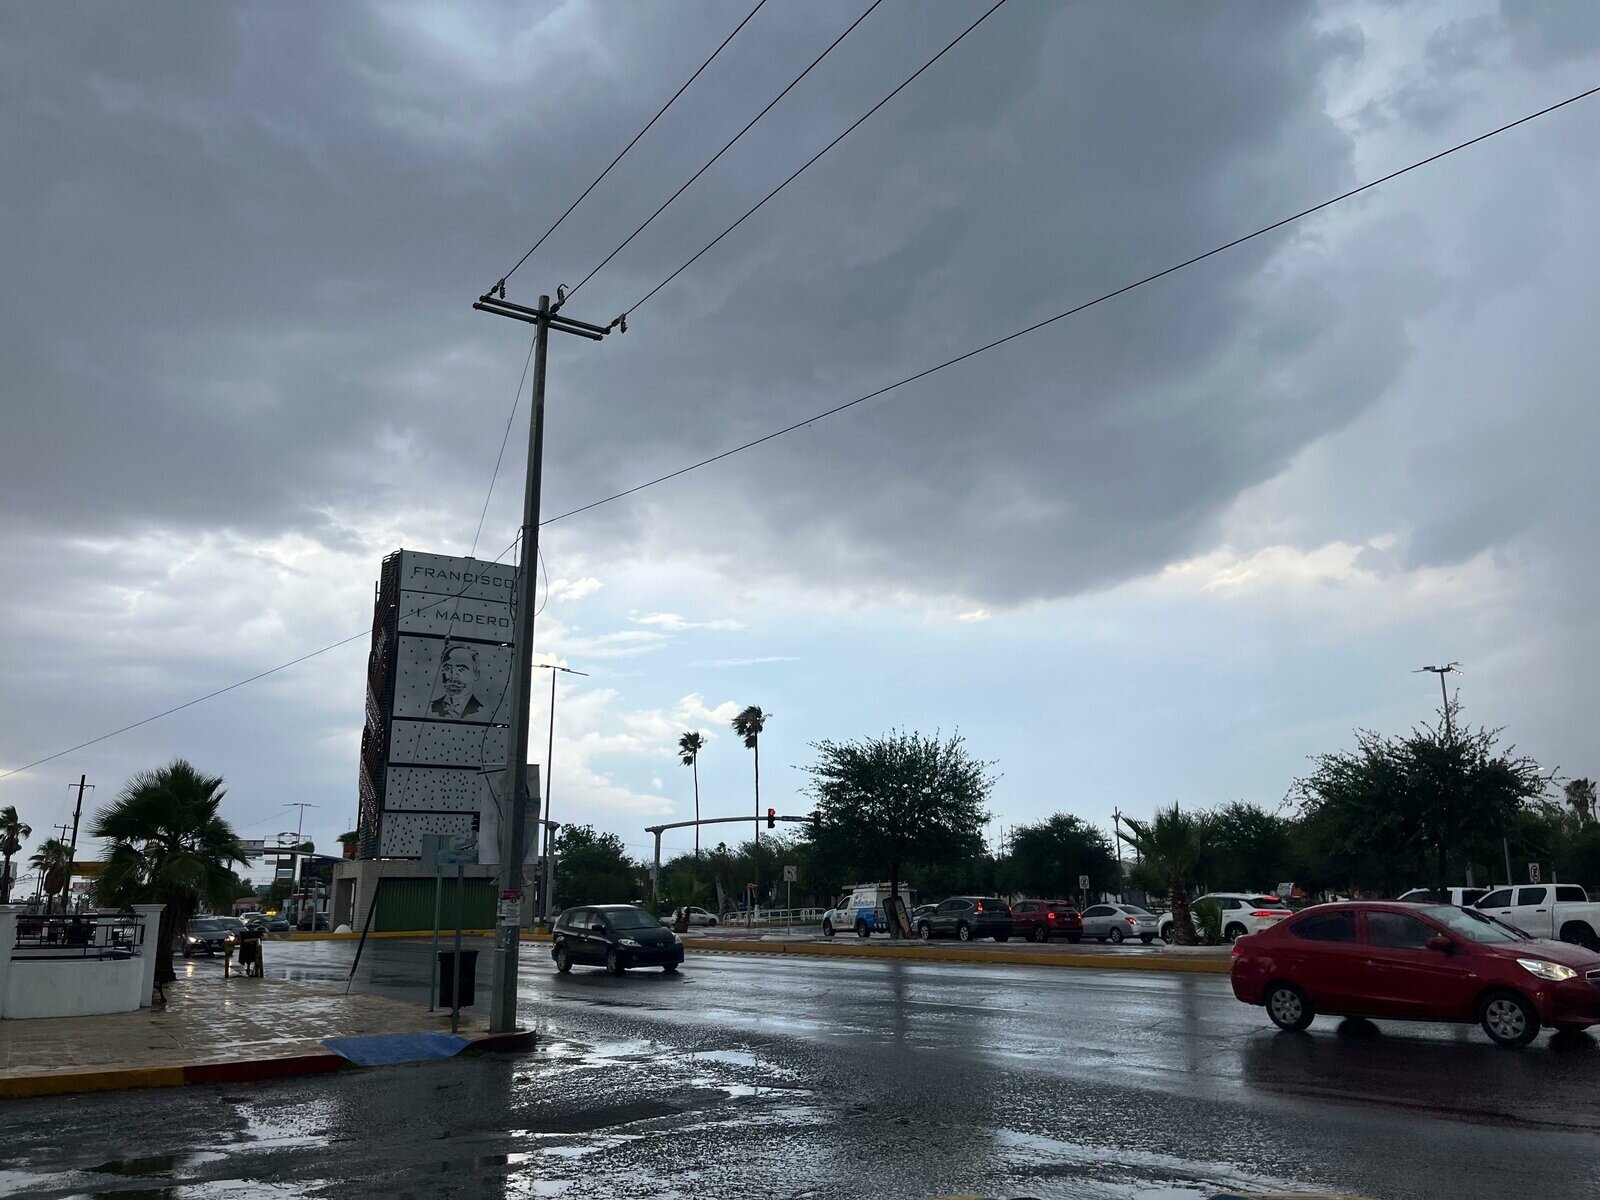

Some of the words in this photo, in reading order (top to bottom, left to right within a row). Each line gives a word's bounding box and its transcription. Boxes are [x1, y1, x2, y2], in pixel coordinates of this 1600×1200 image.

[413, 566, 514, 589] FRANCISCO
[416, 608, 427, 618] I.
[435, 610, 509, 628] MADERO
